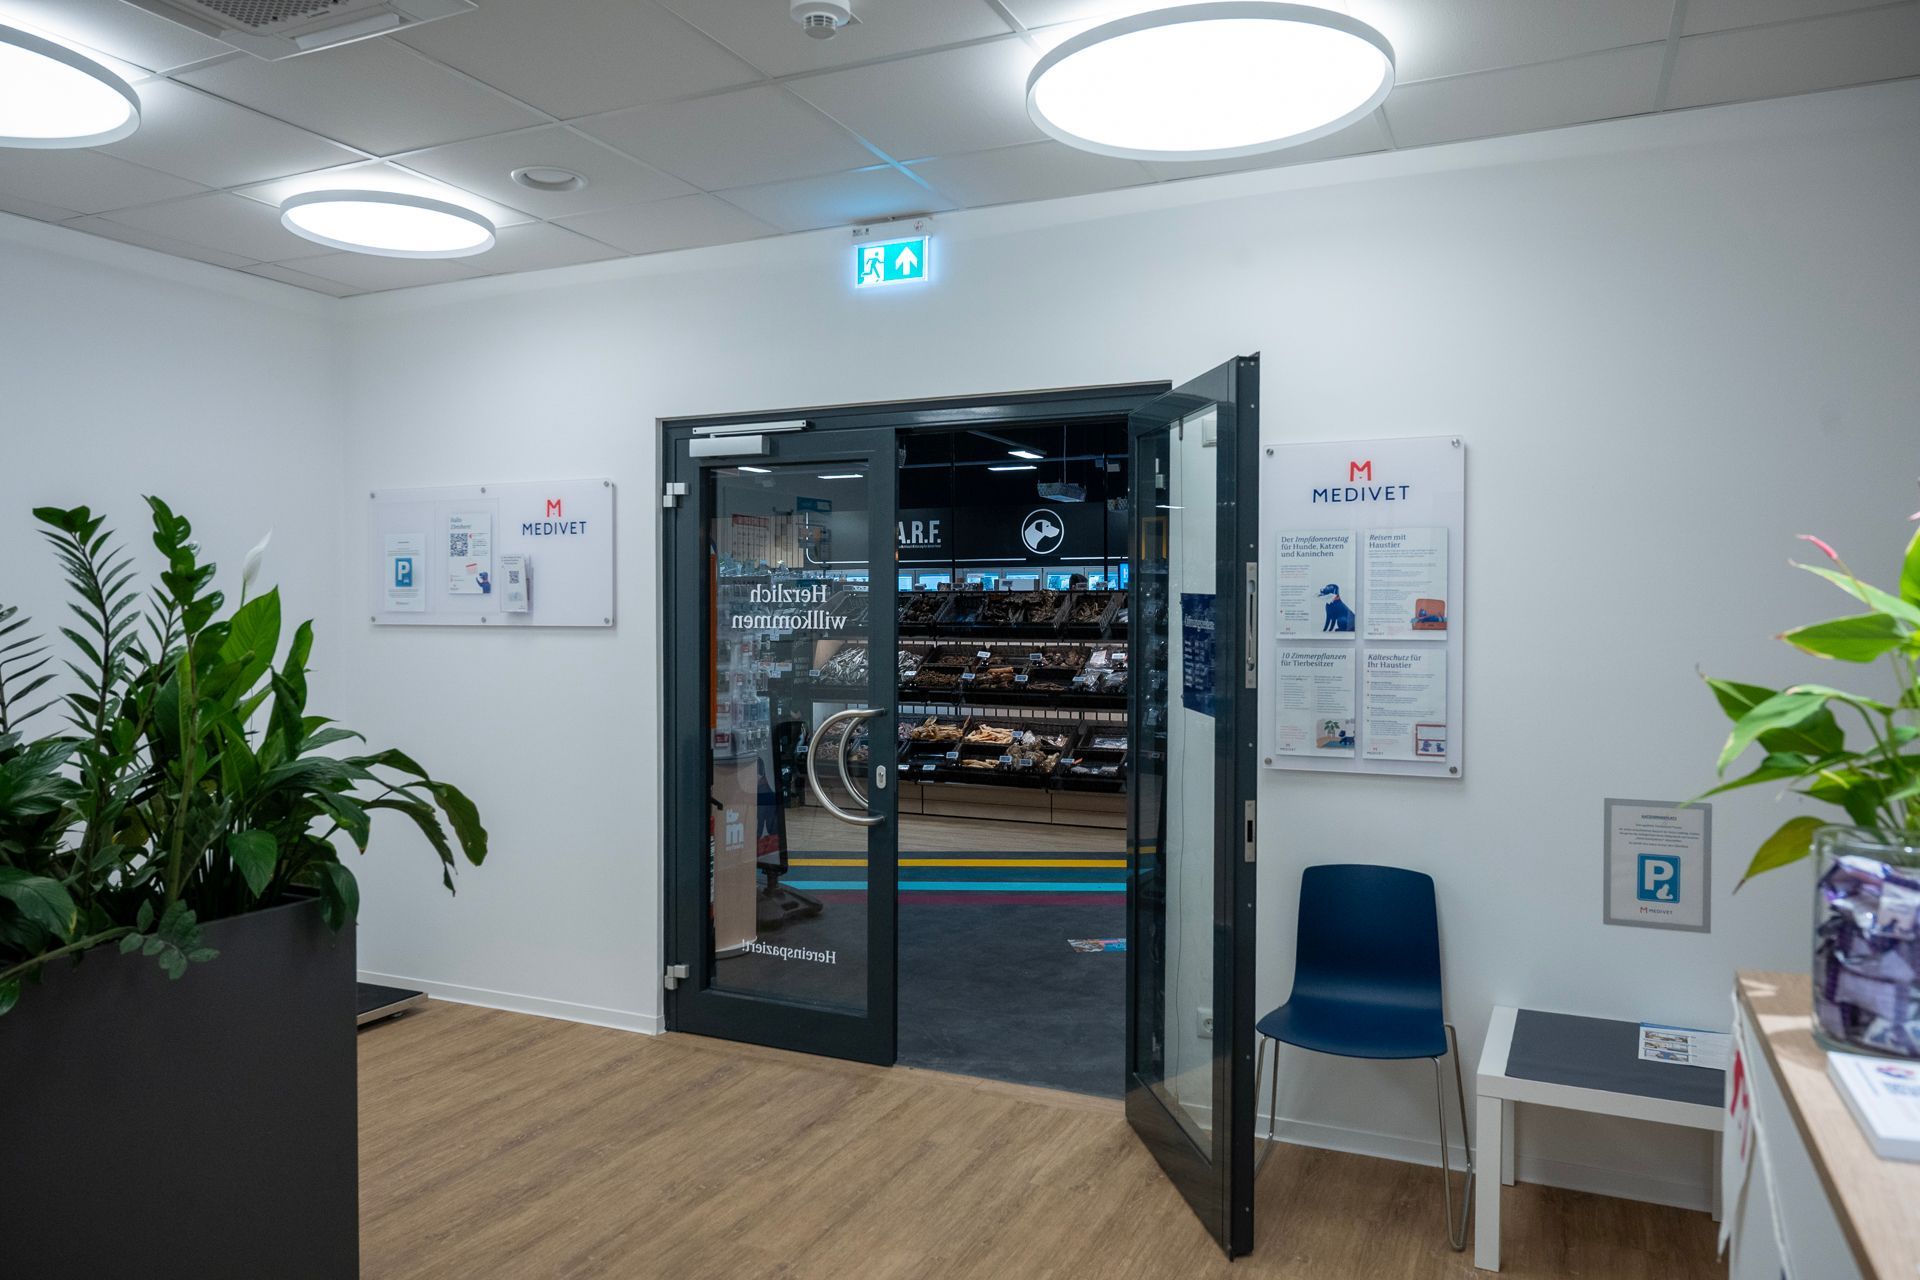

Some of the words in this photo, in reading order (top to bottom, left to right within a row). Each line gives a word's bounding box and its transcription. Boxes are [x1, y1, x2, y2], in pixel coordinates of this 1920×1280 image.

[1349, 460, 1372, 482] M
[1312, 485, 1410, 503] MEDIVET
[546, 498, 562, 518] M
[522, 521, 587, 536] MEDIVET
[1295, 535, 1350, 544] Impfdonnerstag
[1393, 533, 1406, 541] mit
[1292, 543, 1319, 551] Hunde,
[1369, 541, 1401, 549] Haustier
[1280, 550, 1295, 558] und
[1296, 550, 1334, 558] Kaninchen
[1282, 652, 1291, 660] 10
[1291, 652, 1347, 661] Zimmerpflanzen
[1410, 654, 1422, 662] für
[1280, 659, 1292, 667] für
[1293, 660, 1334, 668] Tierbesitzer
[1367, 661, 1379, 669] Ihr
[1380, 661, 1411, 669] Haustier
[1644, 859, 1674, 891] P
